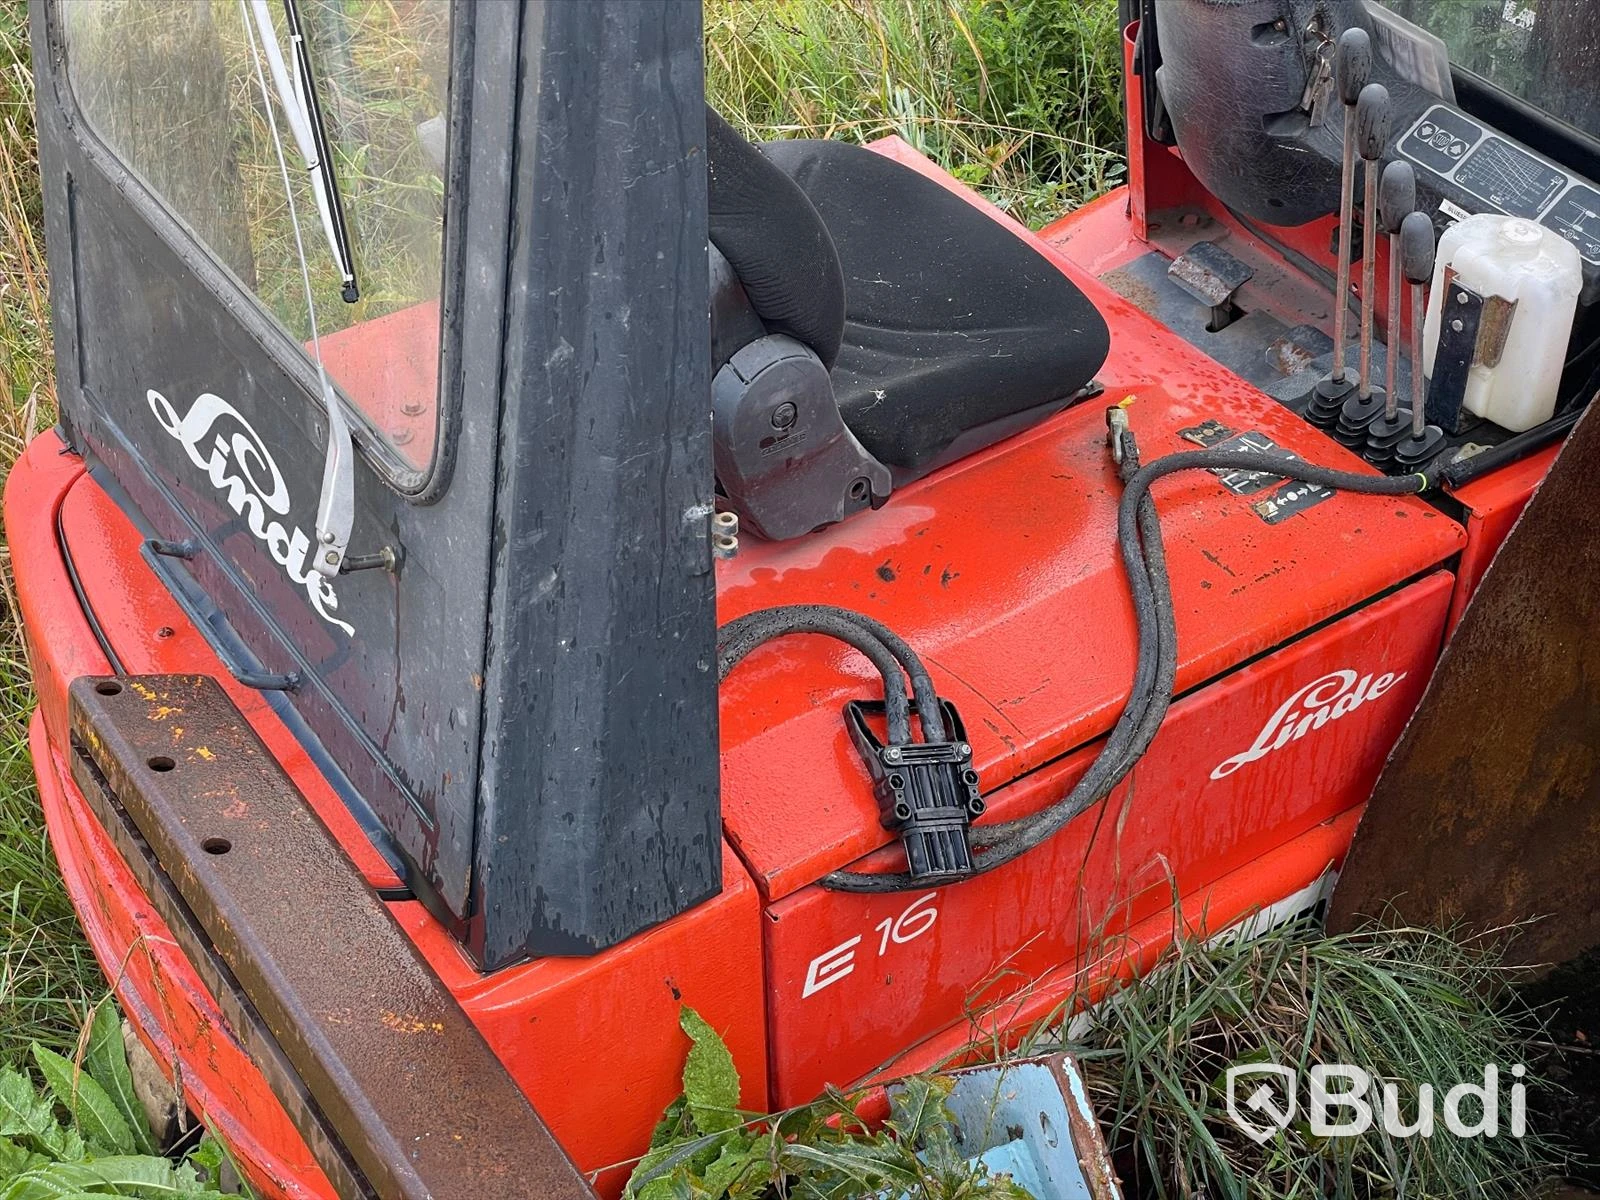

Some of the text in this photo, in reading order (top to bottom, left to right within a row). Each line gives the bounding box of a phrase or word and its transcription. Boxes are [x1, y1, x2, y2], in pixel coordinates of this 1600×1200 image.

[1433, 134, 1450, 147] STOP
[146, 388, 356, 638] Linde
[1209, 669, 1408, 780] Linde
[801, 892, 937, 999] E 16
